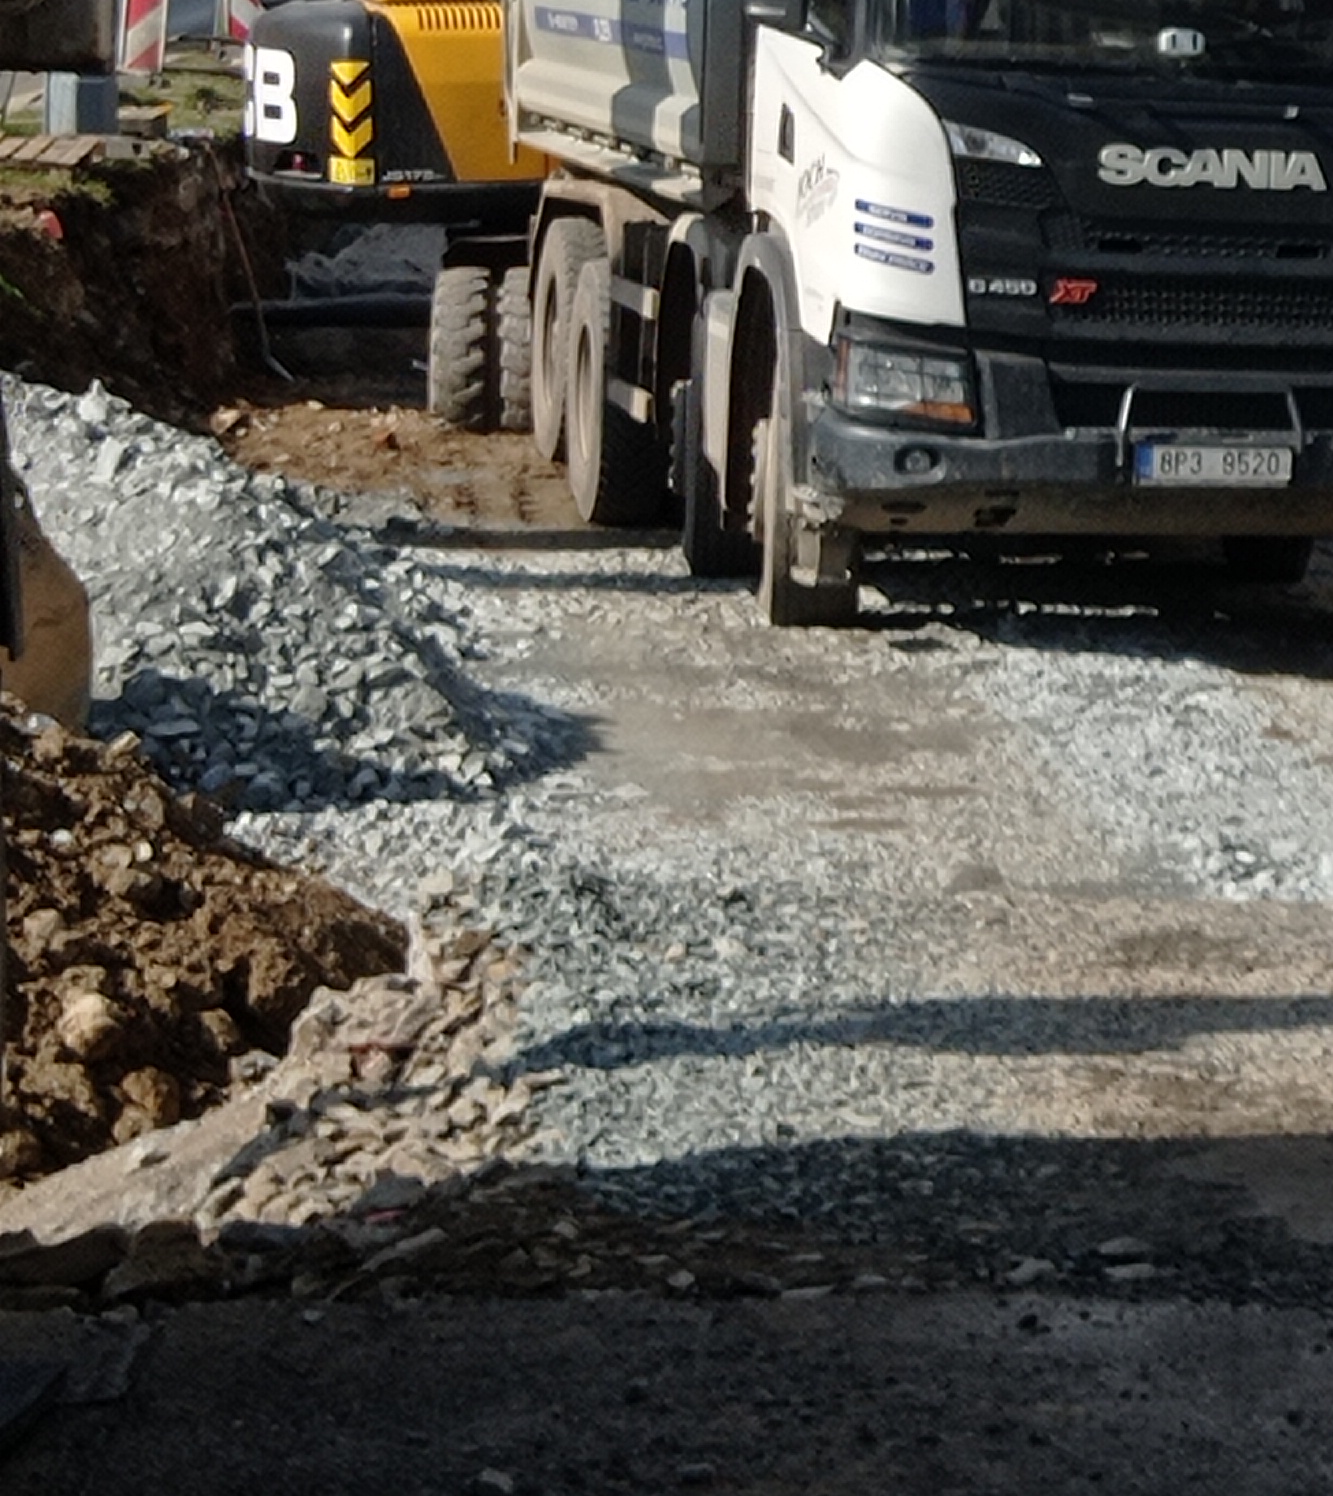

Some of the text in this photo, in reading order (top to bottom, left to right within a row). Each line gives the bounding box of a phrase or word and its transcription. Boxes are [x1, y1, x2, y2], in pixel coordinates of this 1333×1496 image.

[1098, 144, 1328, 192] SCANIA
[1049, 277, 1098, 305] XT
[1159, 449, 1203, 476] 8P3
